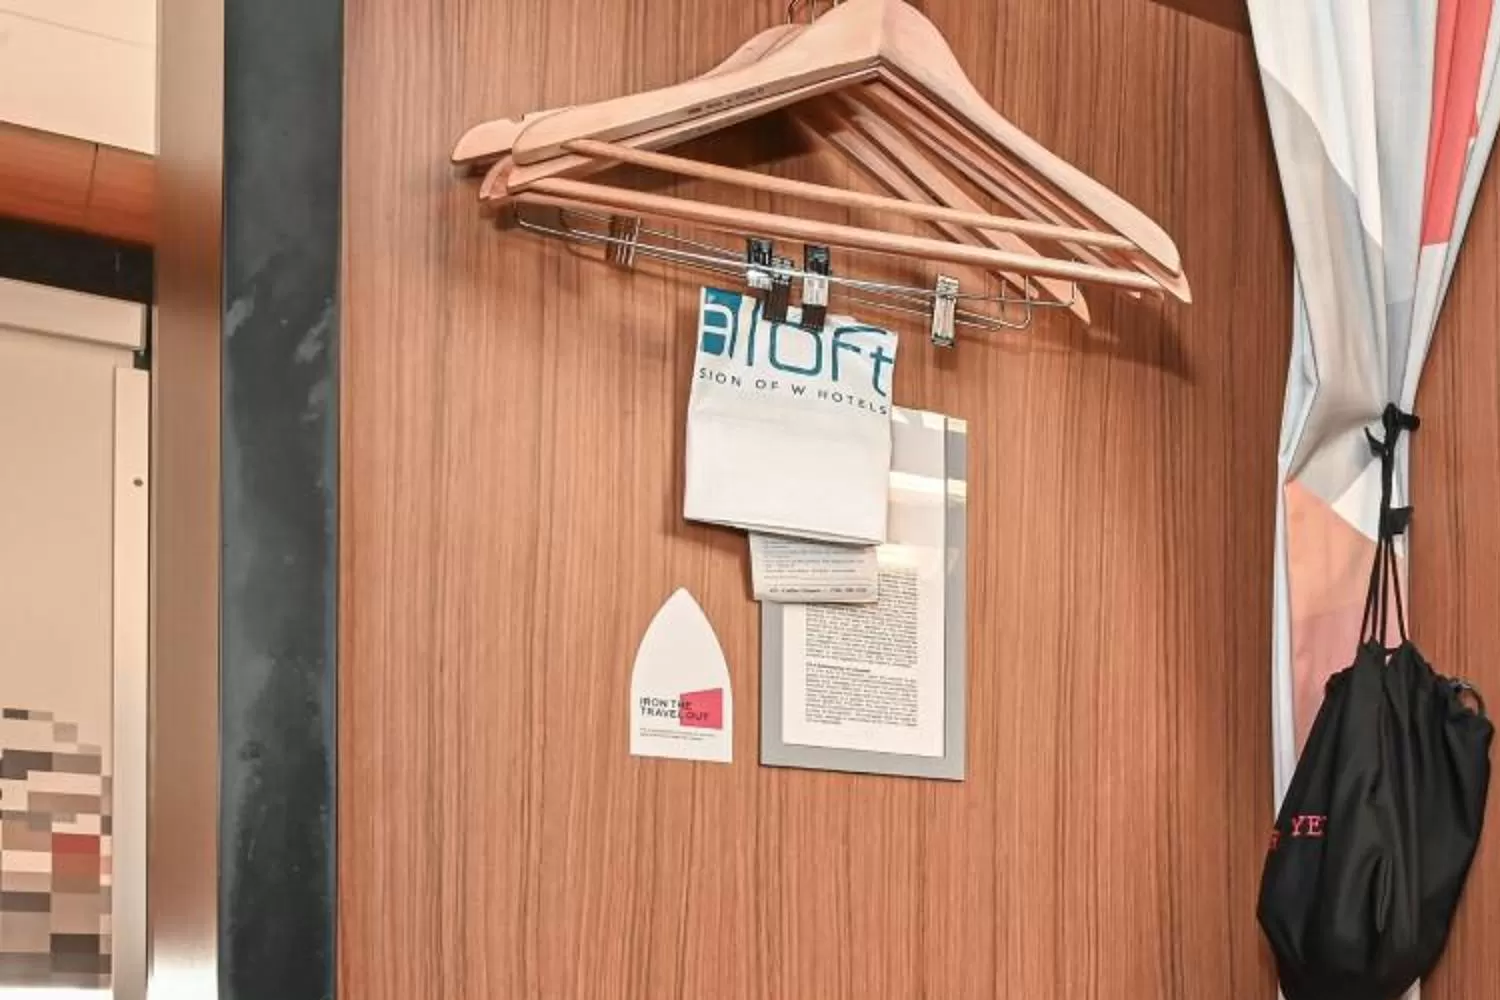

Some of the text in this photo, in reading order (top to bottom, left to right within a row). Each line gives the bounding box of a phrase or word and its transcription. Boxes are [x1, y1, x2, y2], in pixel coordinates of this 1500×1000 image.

[699, 367, 888, 415] SION OF W HOTELS
[639, 697, 693, 711] IRON THE
[640, 706, 709, 721] TRAVEL OUT
[1291, 814, 1328, 837] YE
